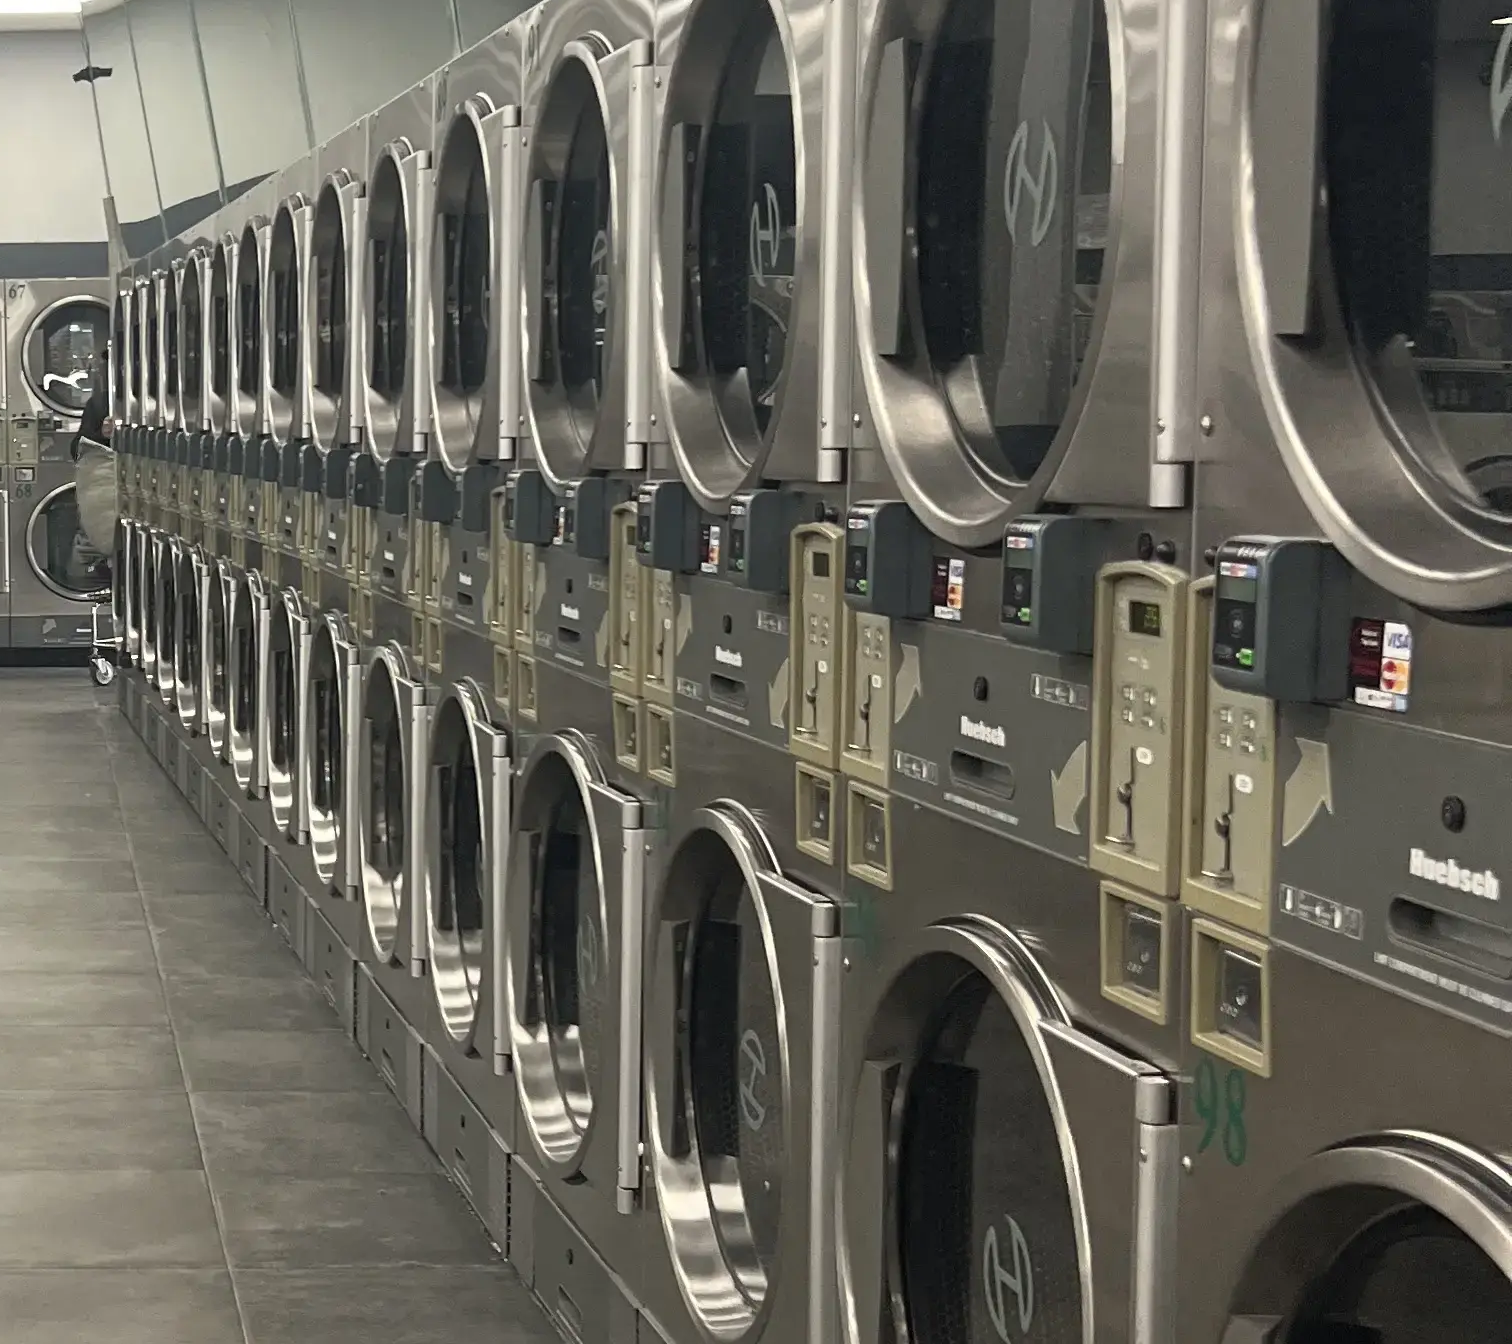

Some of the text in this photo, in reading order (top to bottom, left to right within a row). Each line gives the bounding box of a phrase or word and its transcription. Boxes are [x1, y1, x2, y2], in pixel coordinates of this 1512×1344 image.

[8, 284, 26, 300] 67
[16, 483, 32, 498] 68
[1388, 632, 1410, 649] VISA
[1409, 847, 1500, 901] Huebsch
[1194, 1055, 1248, 1167] 98
